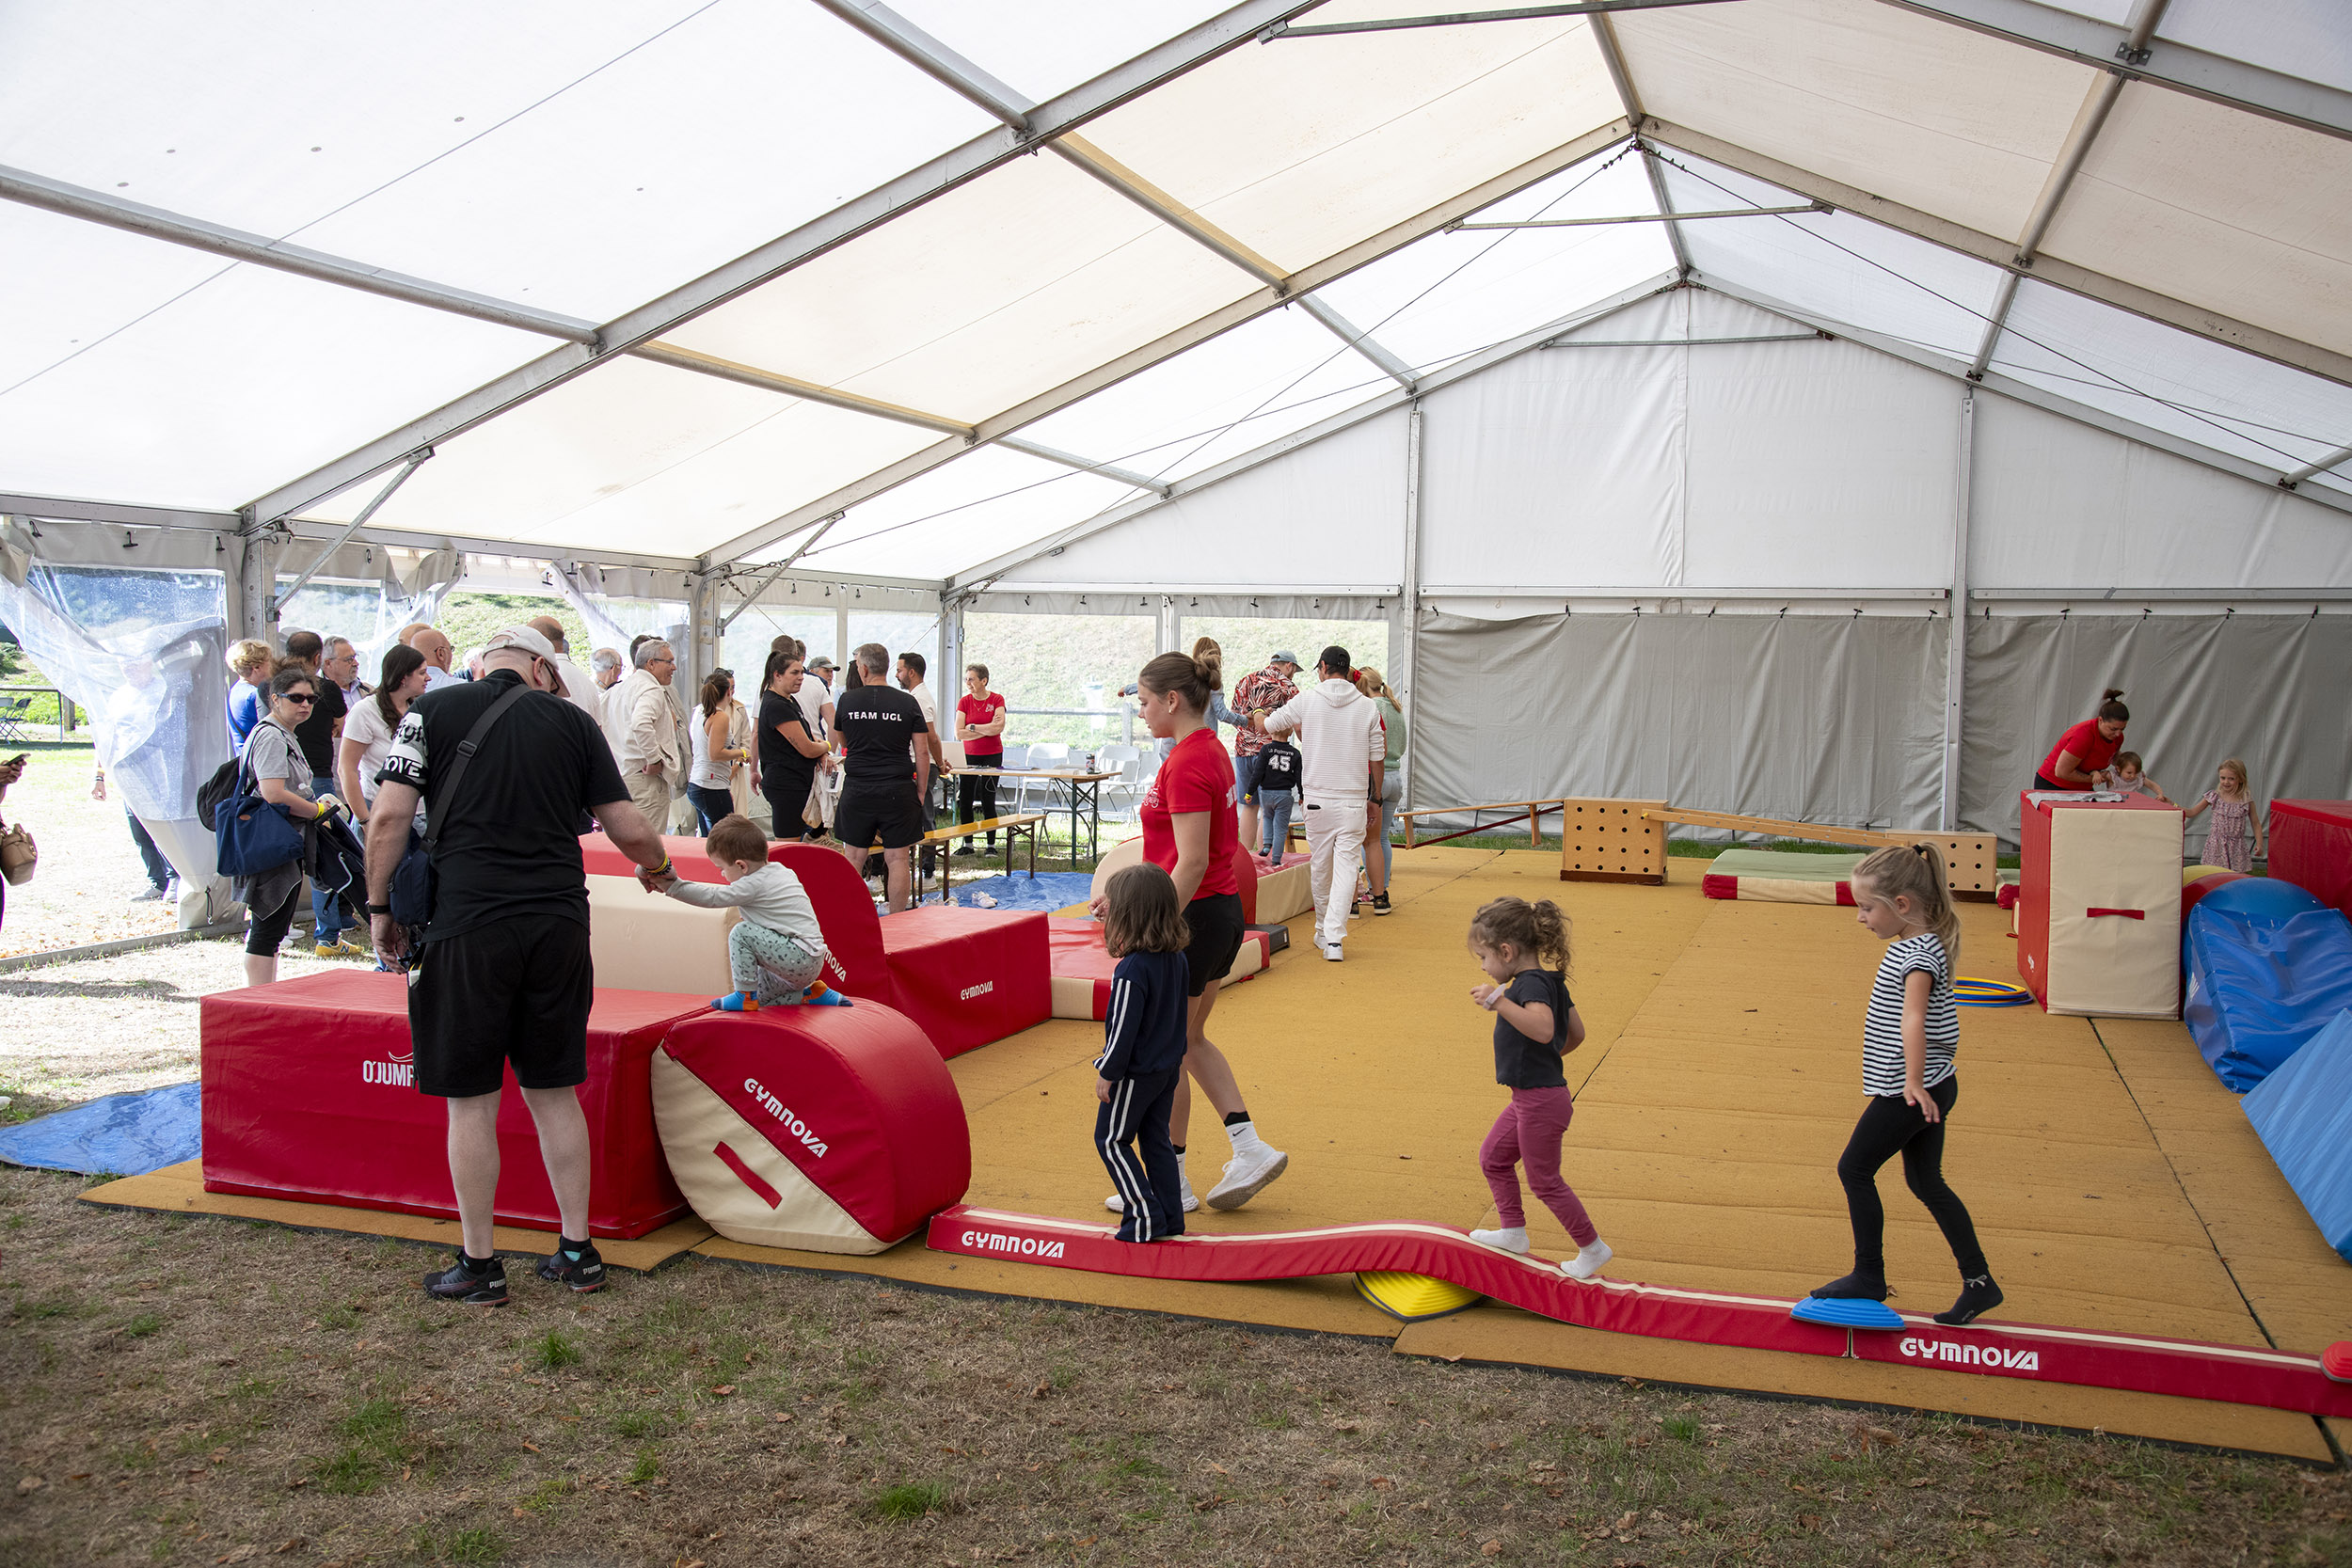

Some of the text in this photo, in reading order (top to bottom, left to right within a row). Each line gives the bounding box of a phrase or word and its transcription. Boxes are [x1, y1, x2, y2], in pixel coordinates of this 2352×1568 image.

[848, 711, 902, 721] TEAM UGL
[1268, 753, 1291, 772] 45
[824, 949, 847, 983] NOVA
[961, 980, 993, 1001] GYMNOVA
[744, 1078, 829, 1159] GYMNOVA
[961, 1230, 1065, 1259] GYMNOVA
[583, 1263, 601, 1275] PUMA
[1899, 1337, 2040, 1371] GYMNOVA
